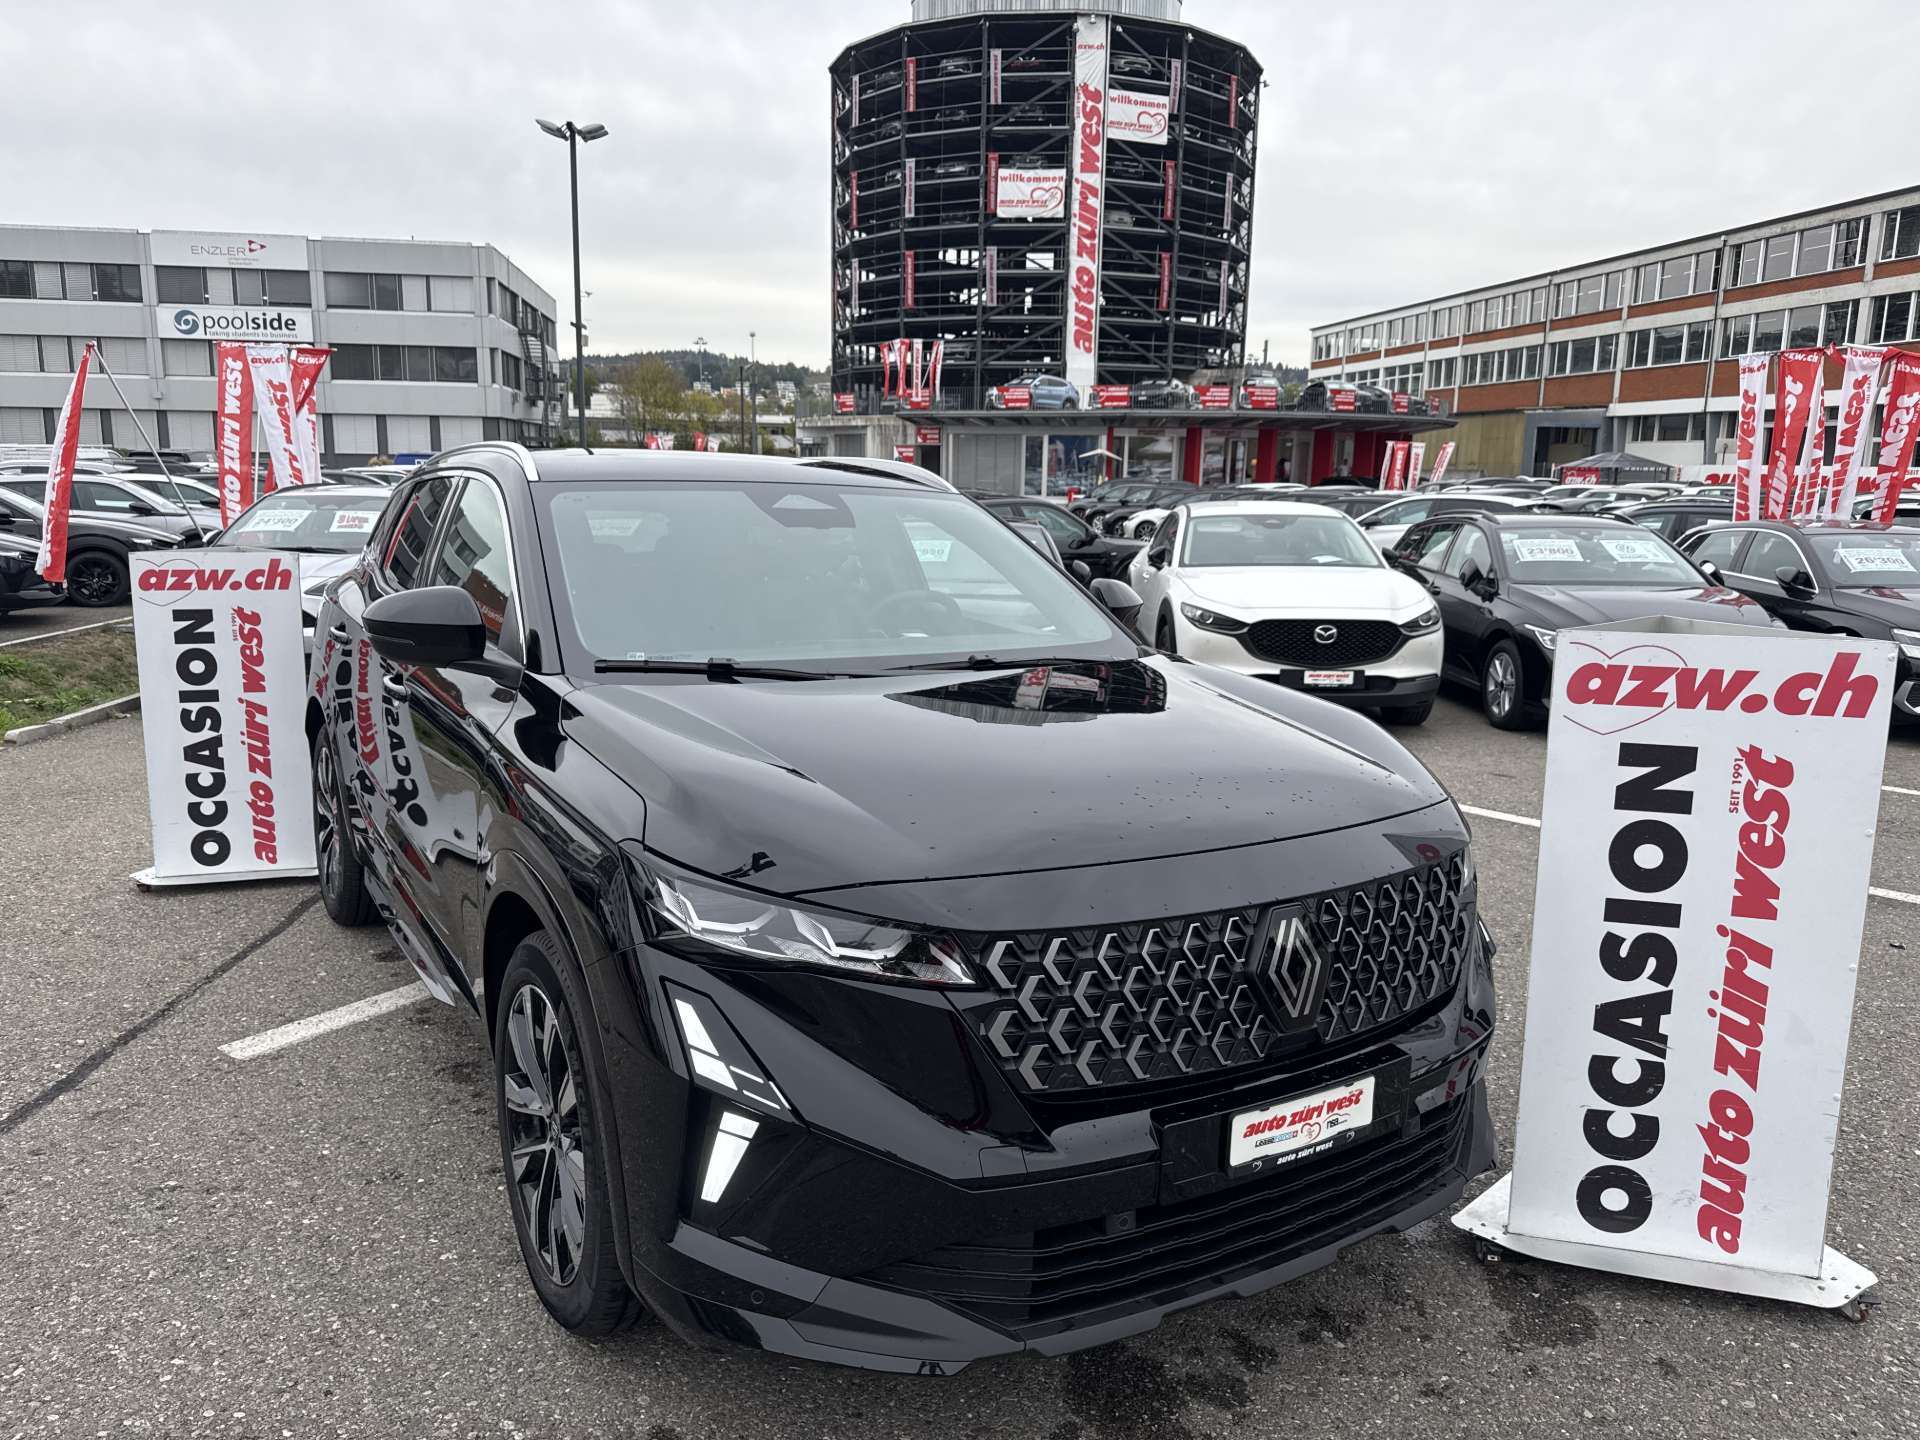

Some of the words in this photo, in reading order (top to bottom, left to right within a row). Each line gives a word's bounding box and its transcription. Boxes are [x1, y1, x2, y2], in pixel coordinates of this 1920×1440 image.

[1079, 82, 1104, 173] west
[1109, 94, 1168, 110] willkommen
[1000, 172, 1064, 183] willkommen
[191, 245, 246, 256] ENZLER
[1072, 177, 1099, 264] züri
[202, 311, 297, 336] poolside
[209, 331, 230, 339] taking
[232, 331, 260, 339] students
[270, 332, 298, 340] business
[1072, 266, 1095, 353] auto
[224, 357, 244, 414] west
[220, 417, 241, 474] züri
[1737, 389, 1757, 460] west
[138, 558, 292, 591] azw.ch
[234, 606, 266, 693] west
[1566, 653, 1879, 719] azw.ch
[172, 609, 231, 867] OCCASION
[238, 697, 273, 779] züri
[1730, 756, 1744, 782] 1991
[246, 779, 278, 865] auto
[1728, 781, 1740, 814] SEIT
[1730, 744, 1795, 922] west
[1575, 742, 1699, 1234] OCCASION
[1707, 924, 1774, 1093] züri
[1243, 1114, 1288, 1138] auto
[1288, 1099, 1327, 1127] züri
[1326, 1088, 1363, 1114] west
[1276, 1153, 1297, 1165] auto
[1297, 1146, 1315, 1158] züri
[1315, 1140, 1334, 1152] west
[1695, 1090, 1756, 1255] auto
